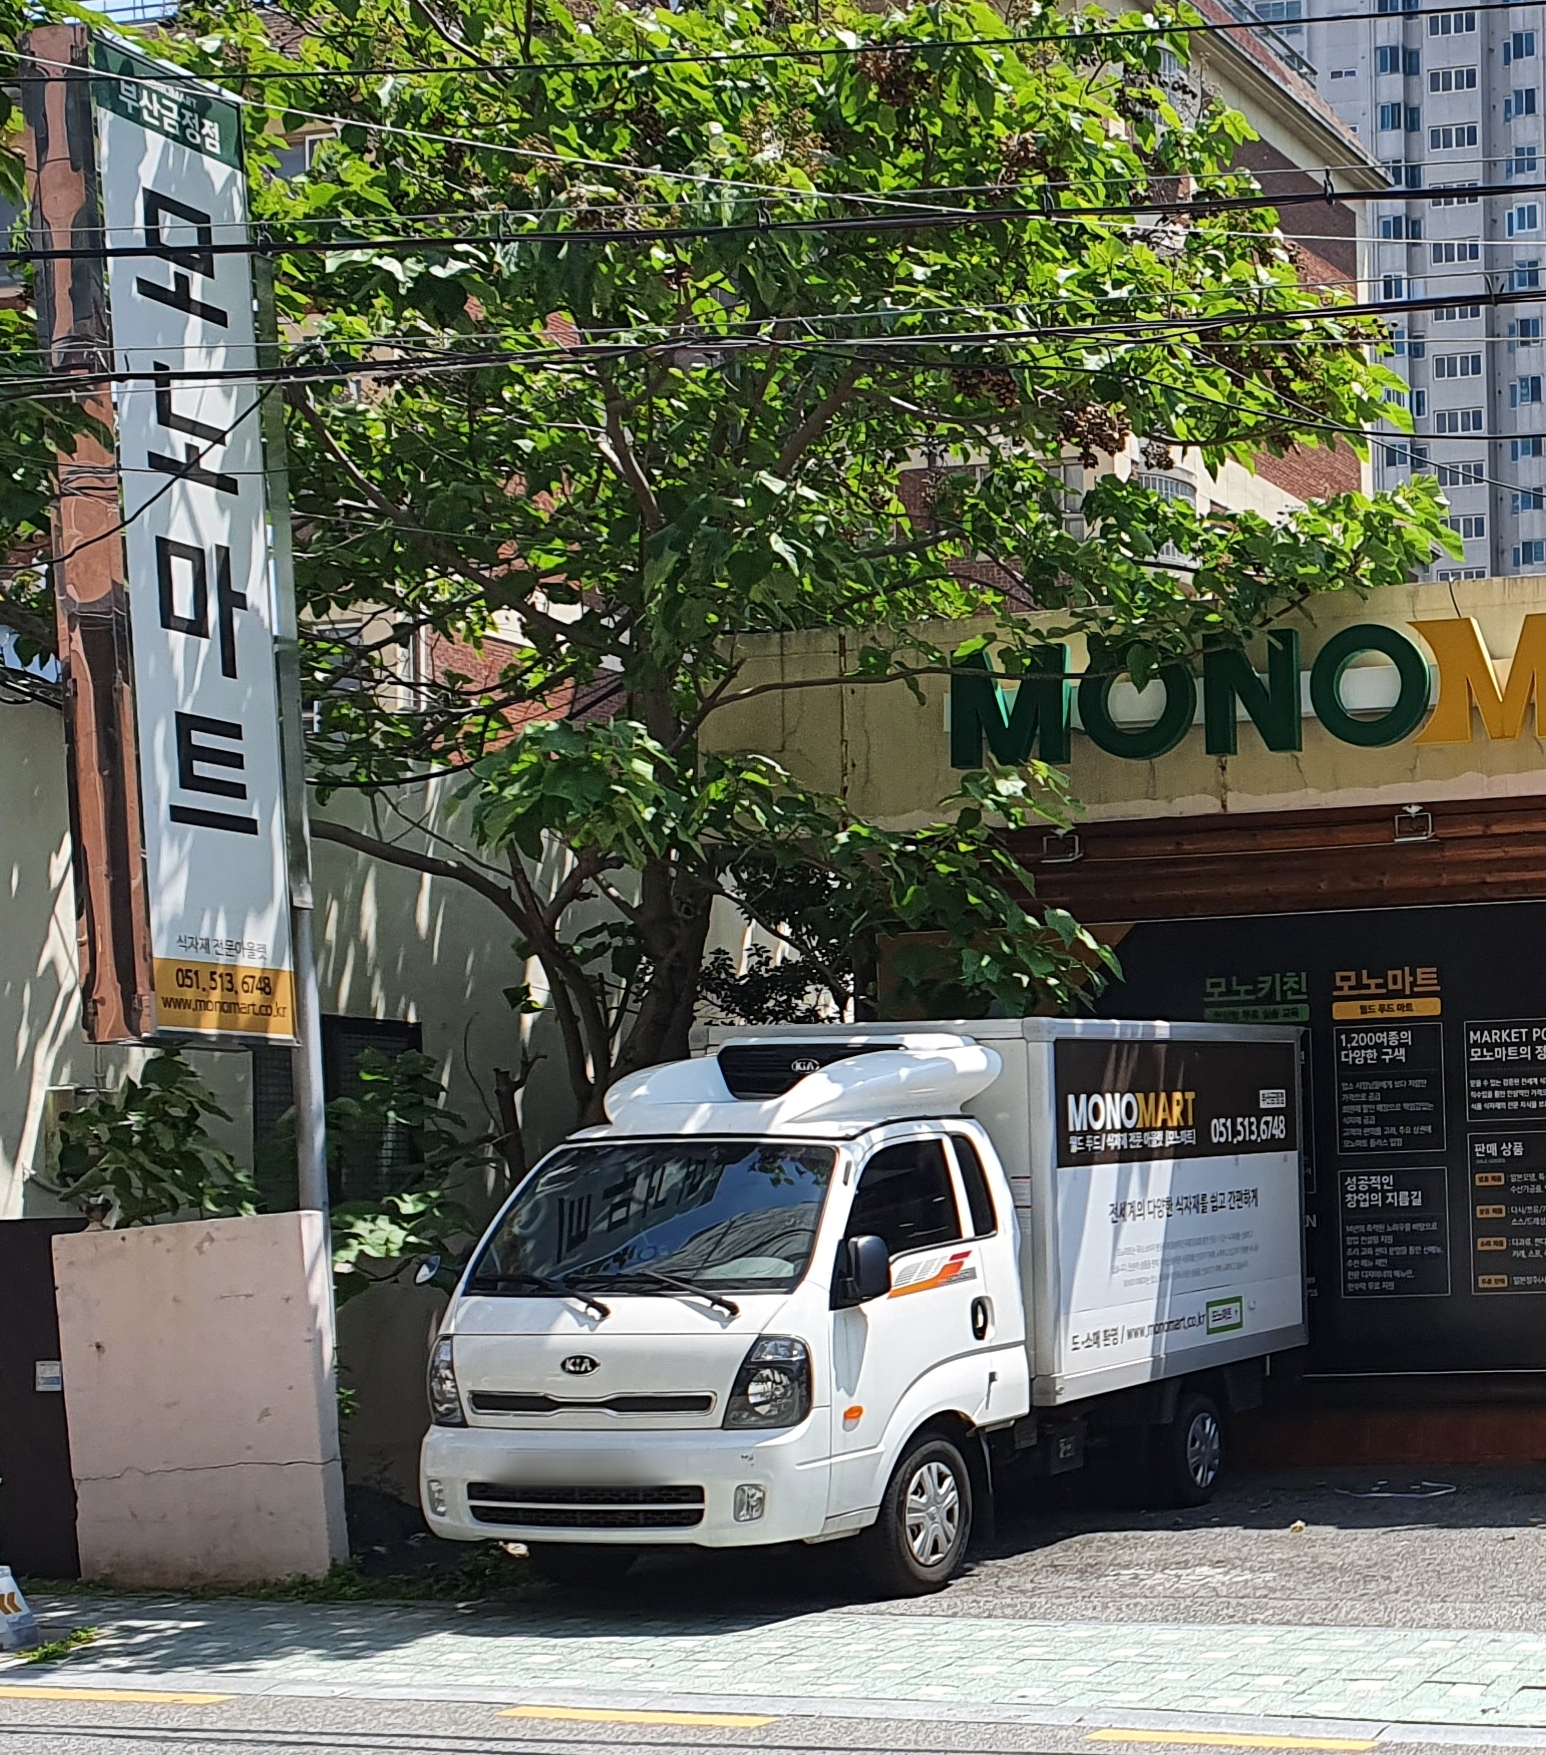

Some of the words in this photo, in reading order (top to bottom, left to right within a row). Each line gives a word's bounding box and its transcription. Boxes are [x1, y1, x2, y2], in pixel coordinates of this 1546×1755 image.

[118, 80, 221, 155] 부산금정점
[136, 186, 258, 836] 모노마트
[176, 934, 210, 954] 식자재
[242, 975, 272, 995] 6748
[1202, 970, 1308, 1002] 모노키친
[1332, 966, 1441, 996] 모노마트
[161, 996, 287, 1018] www.monomart.co.kr
[1396, 1002, 1413, 1013] 마트
[1340, 1030, 1412, 1050] 1,200여종의
[1470, 1028, 1529, 1044] MARKET
[1341, 1048, 1378, 1065] 다양한
[1381, 1047, 1406, 1064] 구색
[1470, 1045, 1531, 1062] 모노마트의
[1067, 1091, 1196, 1132] MONOMART
[1474, 1141, 1498, 1157] 판매
[1500, 1141, 1524, 1157] 상품
[1344, 1174, 1394, 1191] 성공적인
[1108, 1200, 1145, 1224] 전세계의
[1147, 1196, 1173, 1219] 다양한
[1176, 1193, 1208, 1216] 식자재를
[1210, 1192, 1226, 1213] 쉽고
[1228, 1188, 1259, 1211] 간편하게
[1345, 1192, 1382, 1208] 창업의
[1385, 1190, 1422, 1207] 지름길
